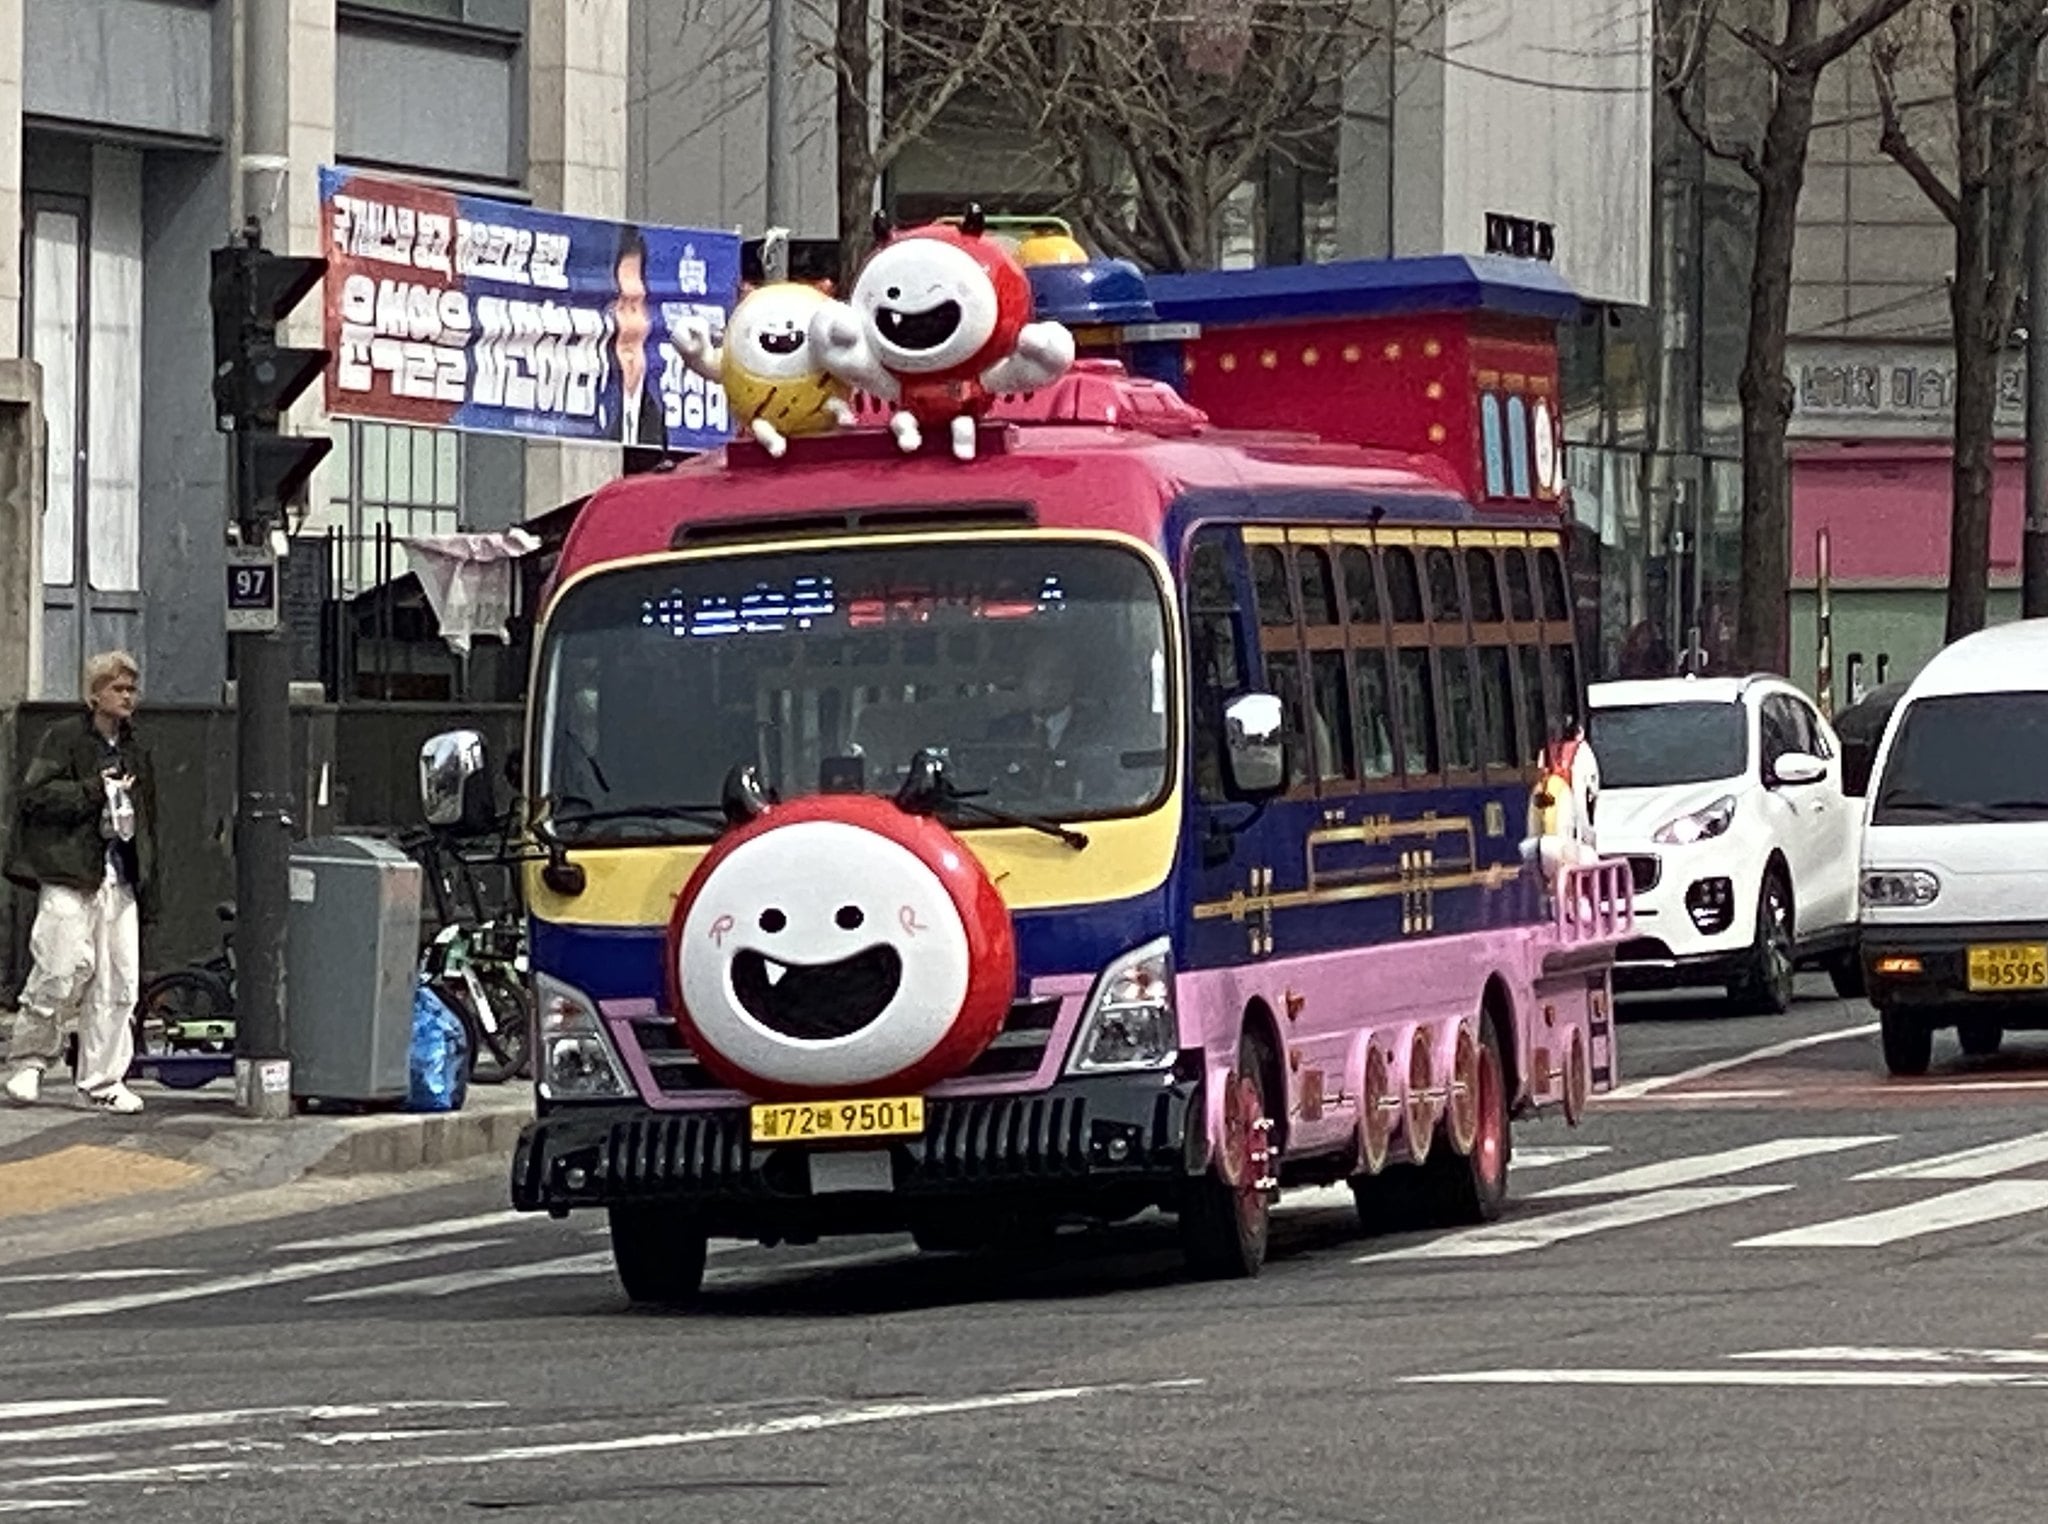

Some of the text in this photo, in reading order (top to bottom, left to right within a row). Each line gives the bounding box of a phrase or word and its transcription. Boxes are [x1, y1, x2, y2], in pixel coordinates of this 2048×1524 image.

[338, 273, 472, 402] 윤석열을
[236, 569, 267, 597] 97
[840, 1101, 910, 1131] 9501
